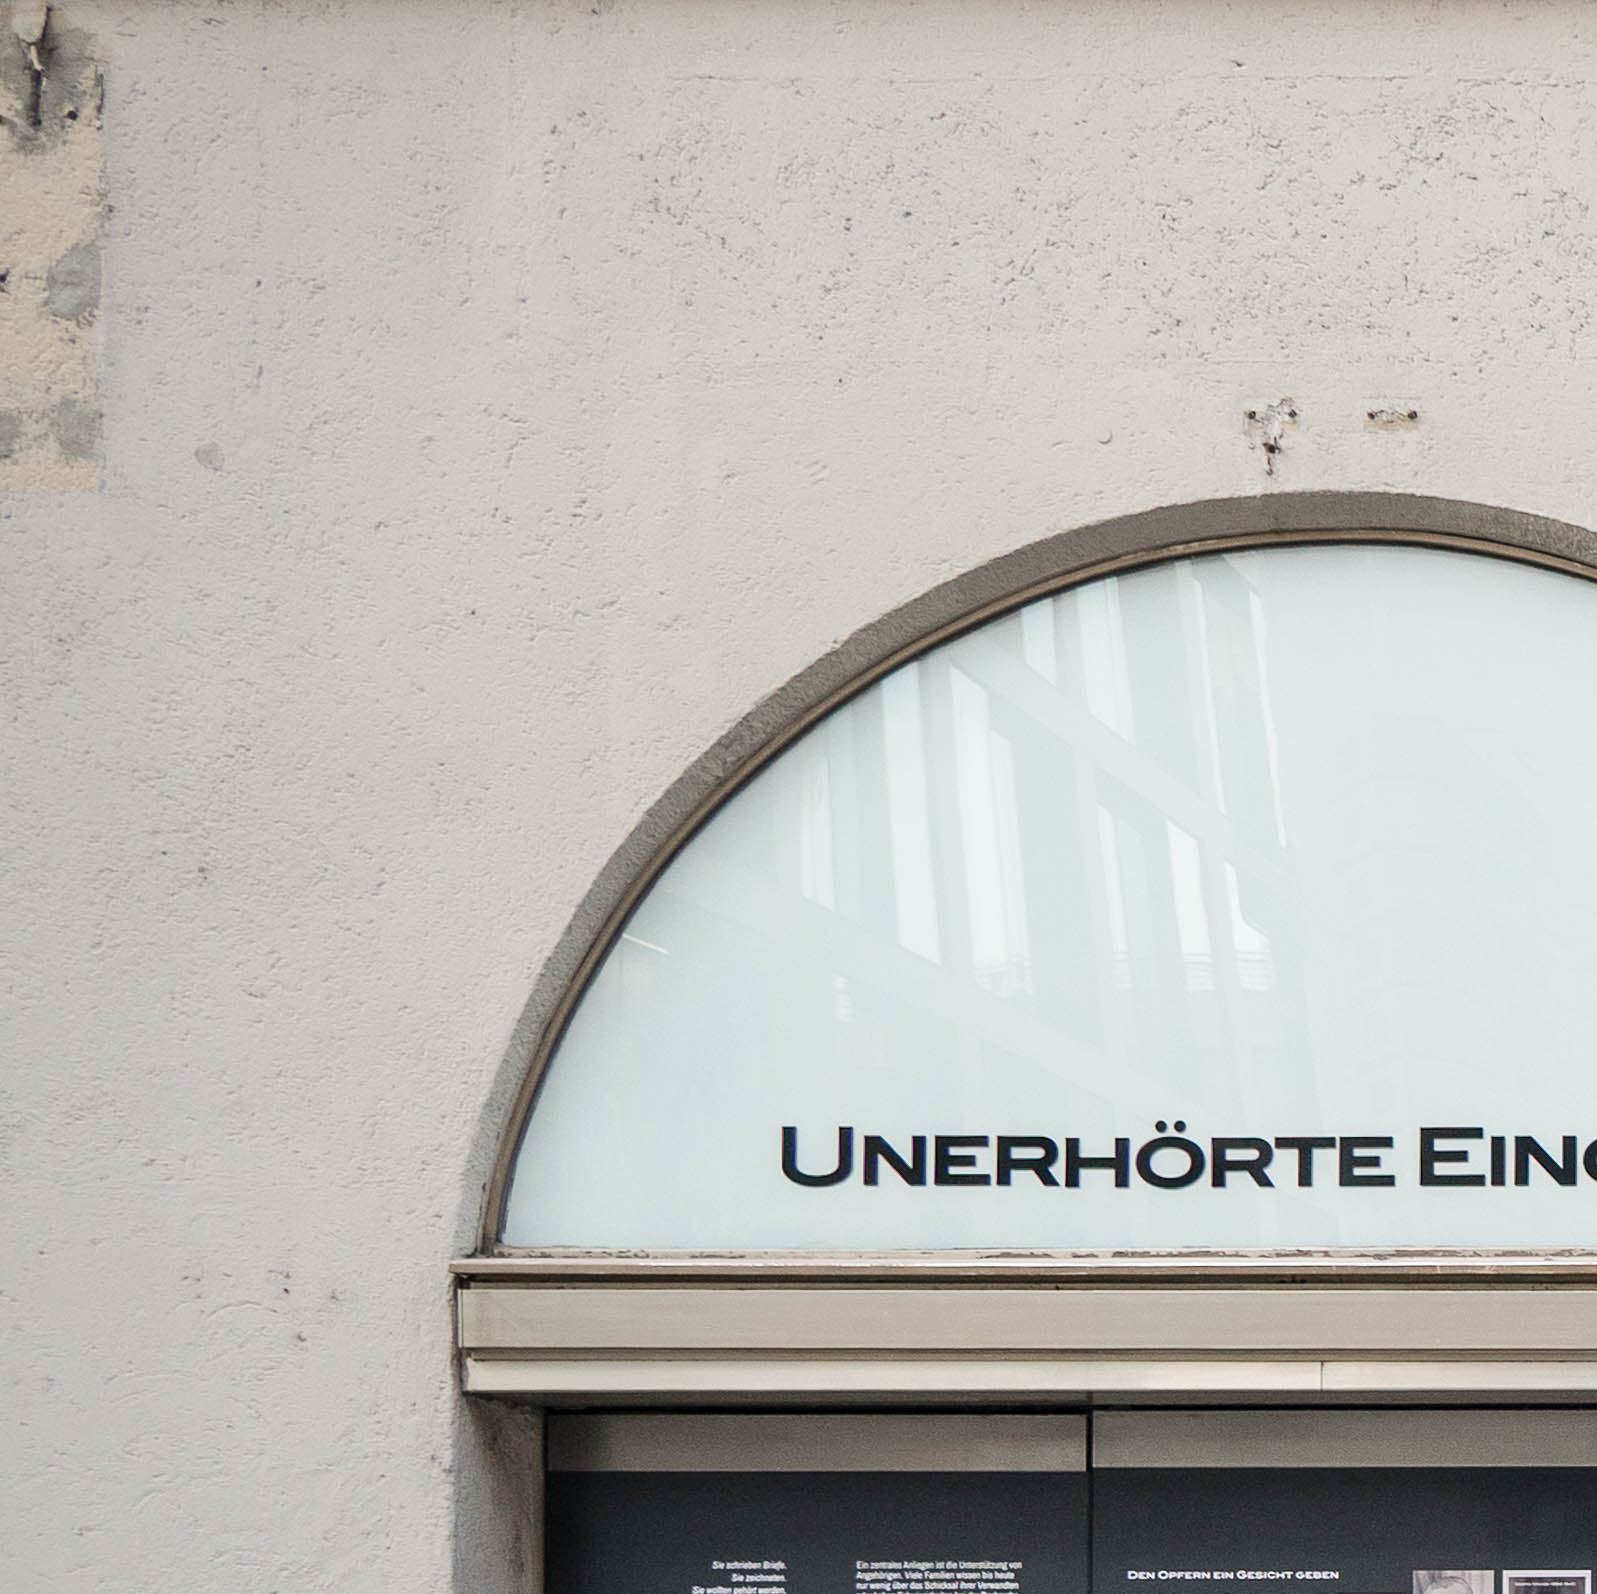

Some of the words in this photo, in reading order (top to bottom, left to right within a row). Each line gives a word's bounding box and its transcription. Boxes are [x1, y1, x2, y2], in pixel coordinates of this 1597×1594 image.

[781, 1120, 1396, 1190] UNERHÖRTE
[1127, 1570, 1156, 1579] DEN
[1157, 1570, 1211, 1579] OPFERN
[1212, 1570, 1234, 1579] EIN
[1236, 1570, 1294, 1579] GESICHT
[1295, 1570, 1339, 1579] GEBEN
